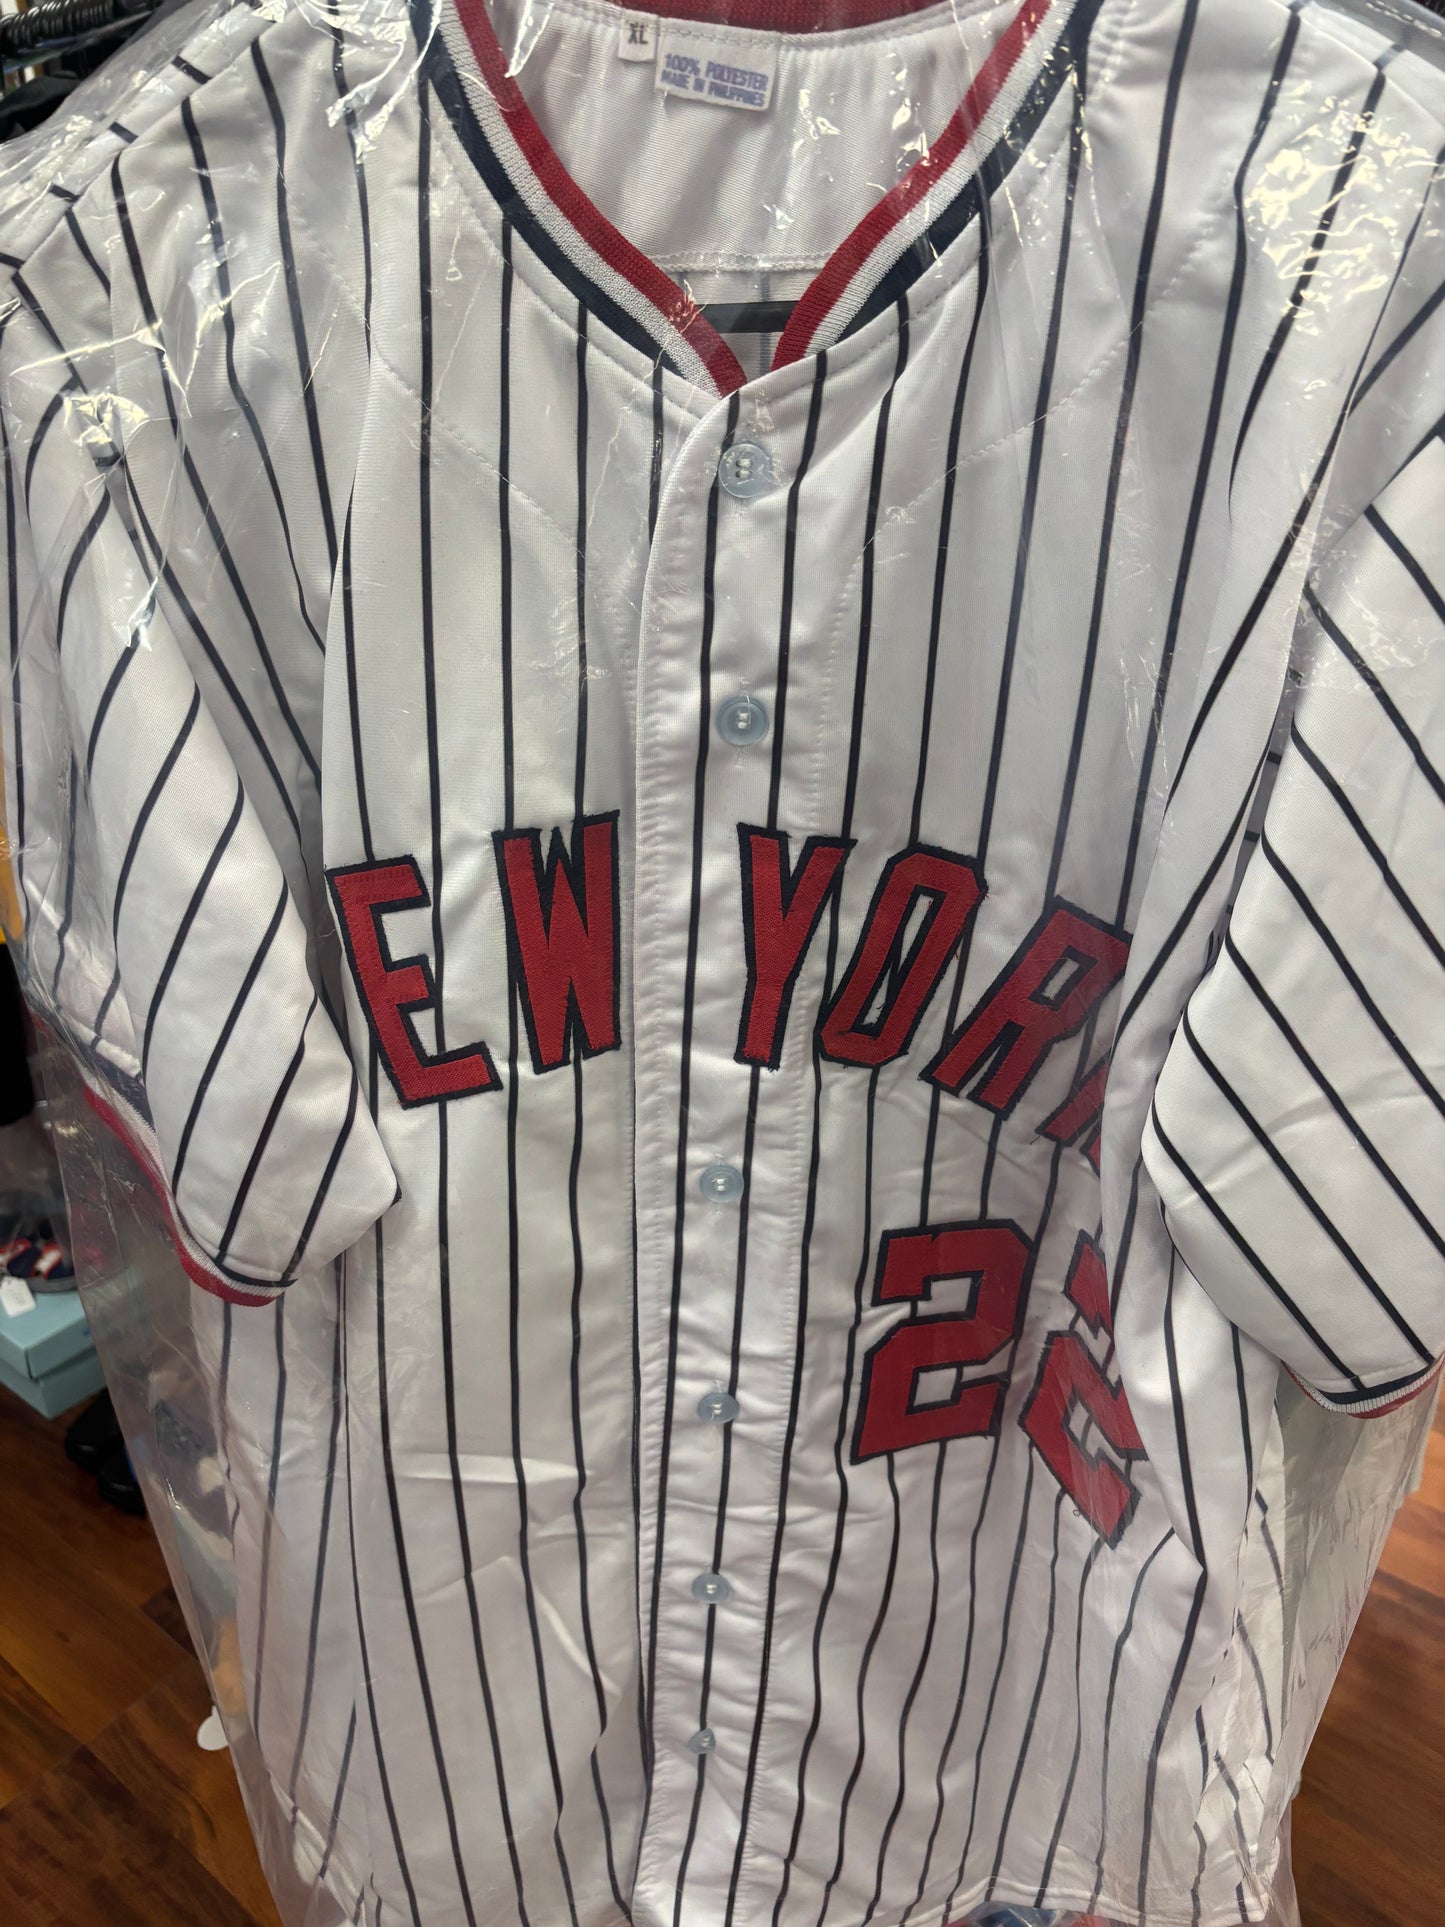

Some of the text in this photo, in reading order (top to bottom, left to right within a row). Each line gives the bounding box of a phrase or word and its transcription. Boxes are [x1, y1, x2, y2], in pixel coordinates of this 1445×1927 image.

[628, 22, 649, 45] XL
[660, 69, 691, 90] MADE
[693, 77, 706, 93] IN
[664, 53, 769, 92] 100% POLYESTER
[850, 1218, 1149, 1550] 22
